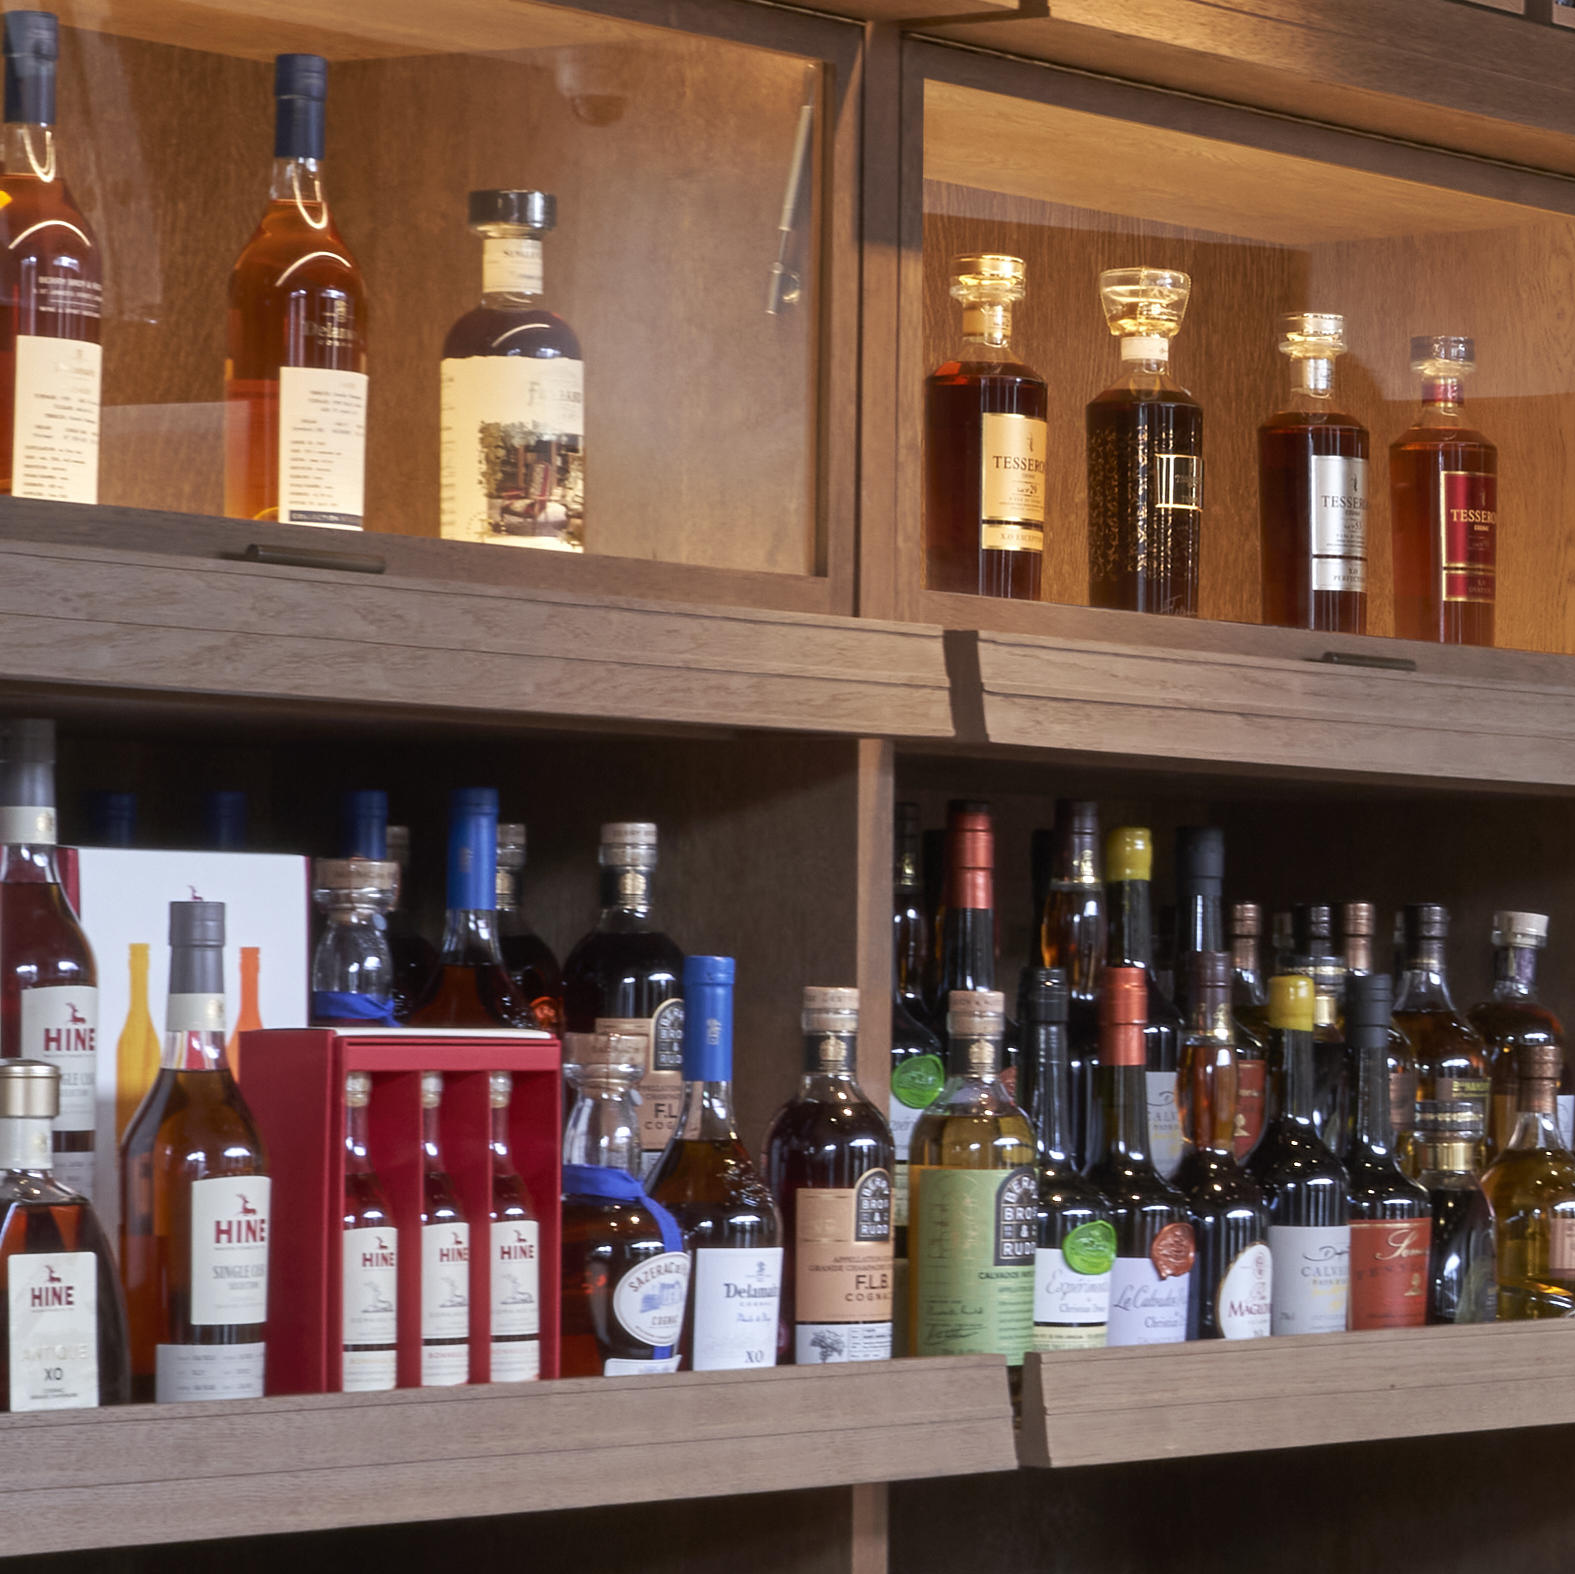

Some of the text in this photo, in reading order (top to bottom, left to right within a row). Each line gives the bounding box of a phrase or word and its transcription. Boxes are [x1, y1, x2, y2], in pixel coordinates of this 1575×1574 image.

[44, 1028, 96, 1052] HINE
[873, 1212, 881, 1222] &
[214, 1218, 266, 1244] HINE
[1020, 1226, 1029, 1238] &
[362, 1252, 396, 1268] HINE
[439, 1247, 469, 1263] HINE
[500, 1244, 535, 1261] HINE
[31, 1286, 75, 1308] HINE
[744, 1350, 765, 1364] XO
[44, 1367, 64, 1381] XO
